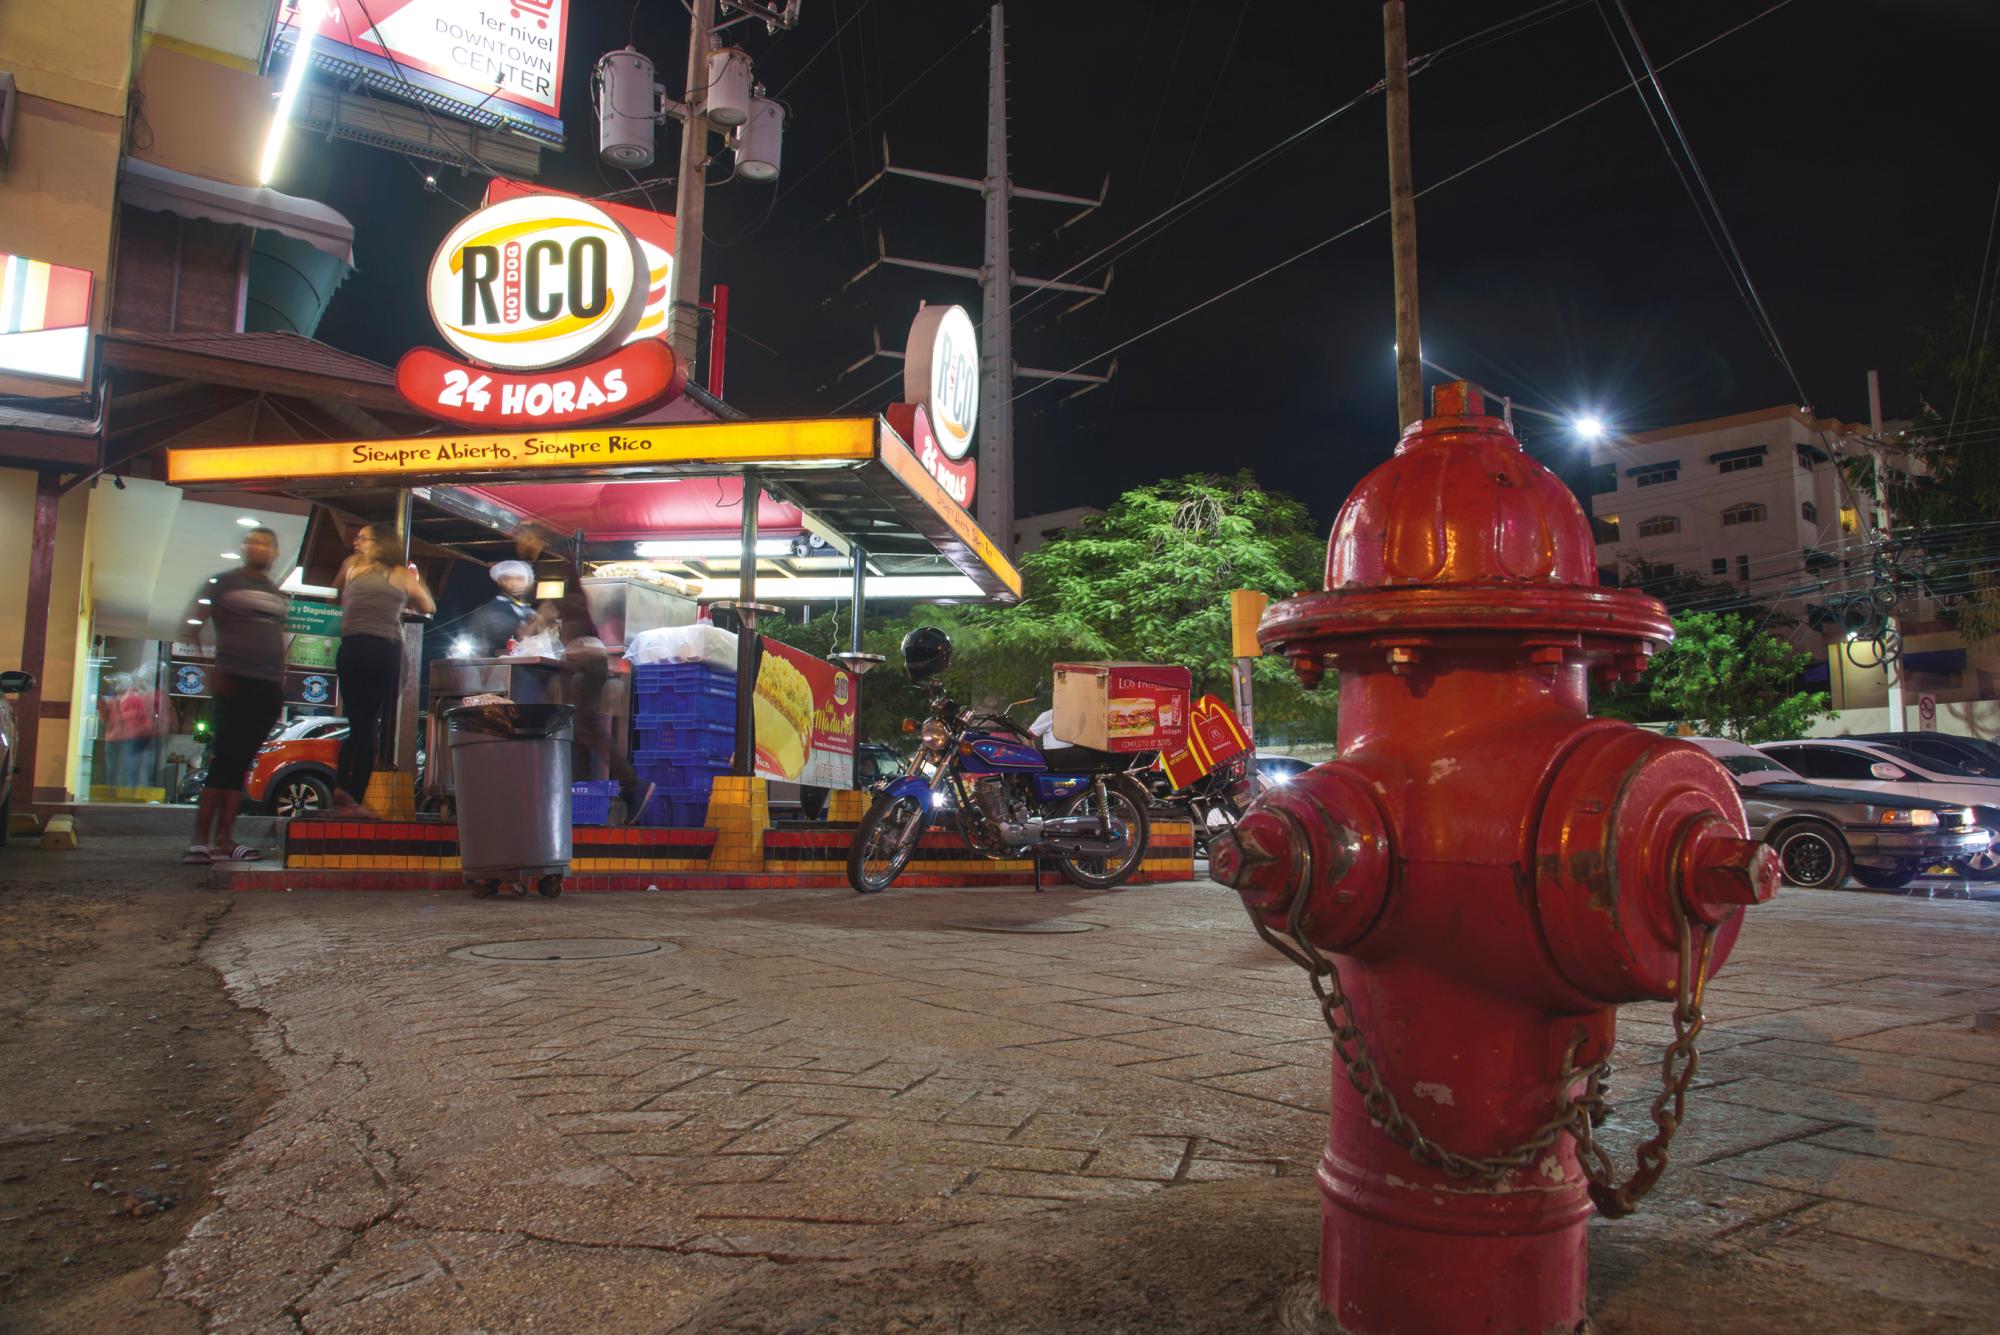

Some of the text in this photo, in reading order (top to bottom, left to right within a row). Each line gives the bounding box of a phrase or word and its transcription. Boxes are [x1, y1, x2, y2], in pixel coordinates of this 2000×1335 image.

[435, 18, 551, 73] DOWNTOWN
[479, 11, 553, 52] 1er nivel
[452, 46, 550, 96] CENTER
[506, 246, 519, 320] HOT DOG
[438, 368, 628, 416] 24 HORAS
[353, 436, 652, 466] Siempre Abierto, Siempre Rico
